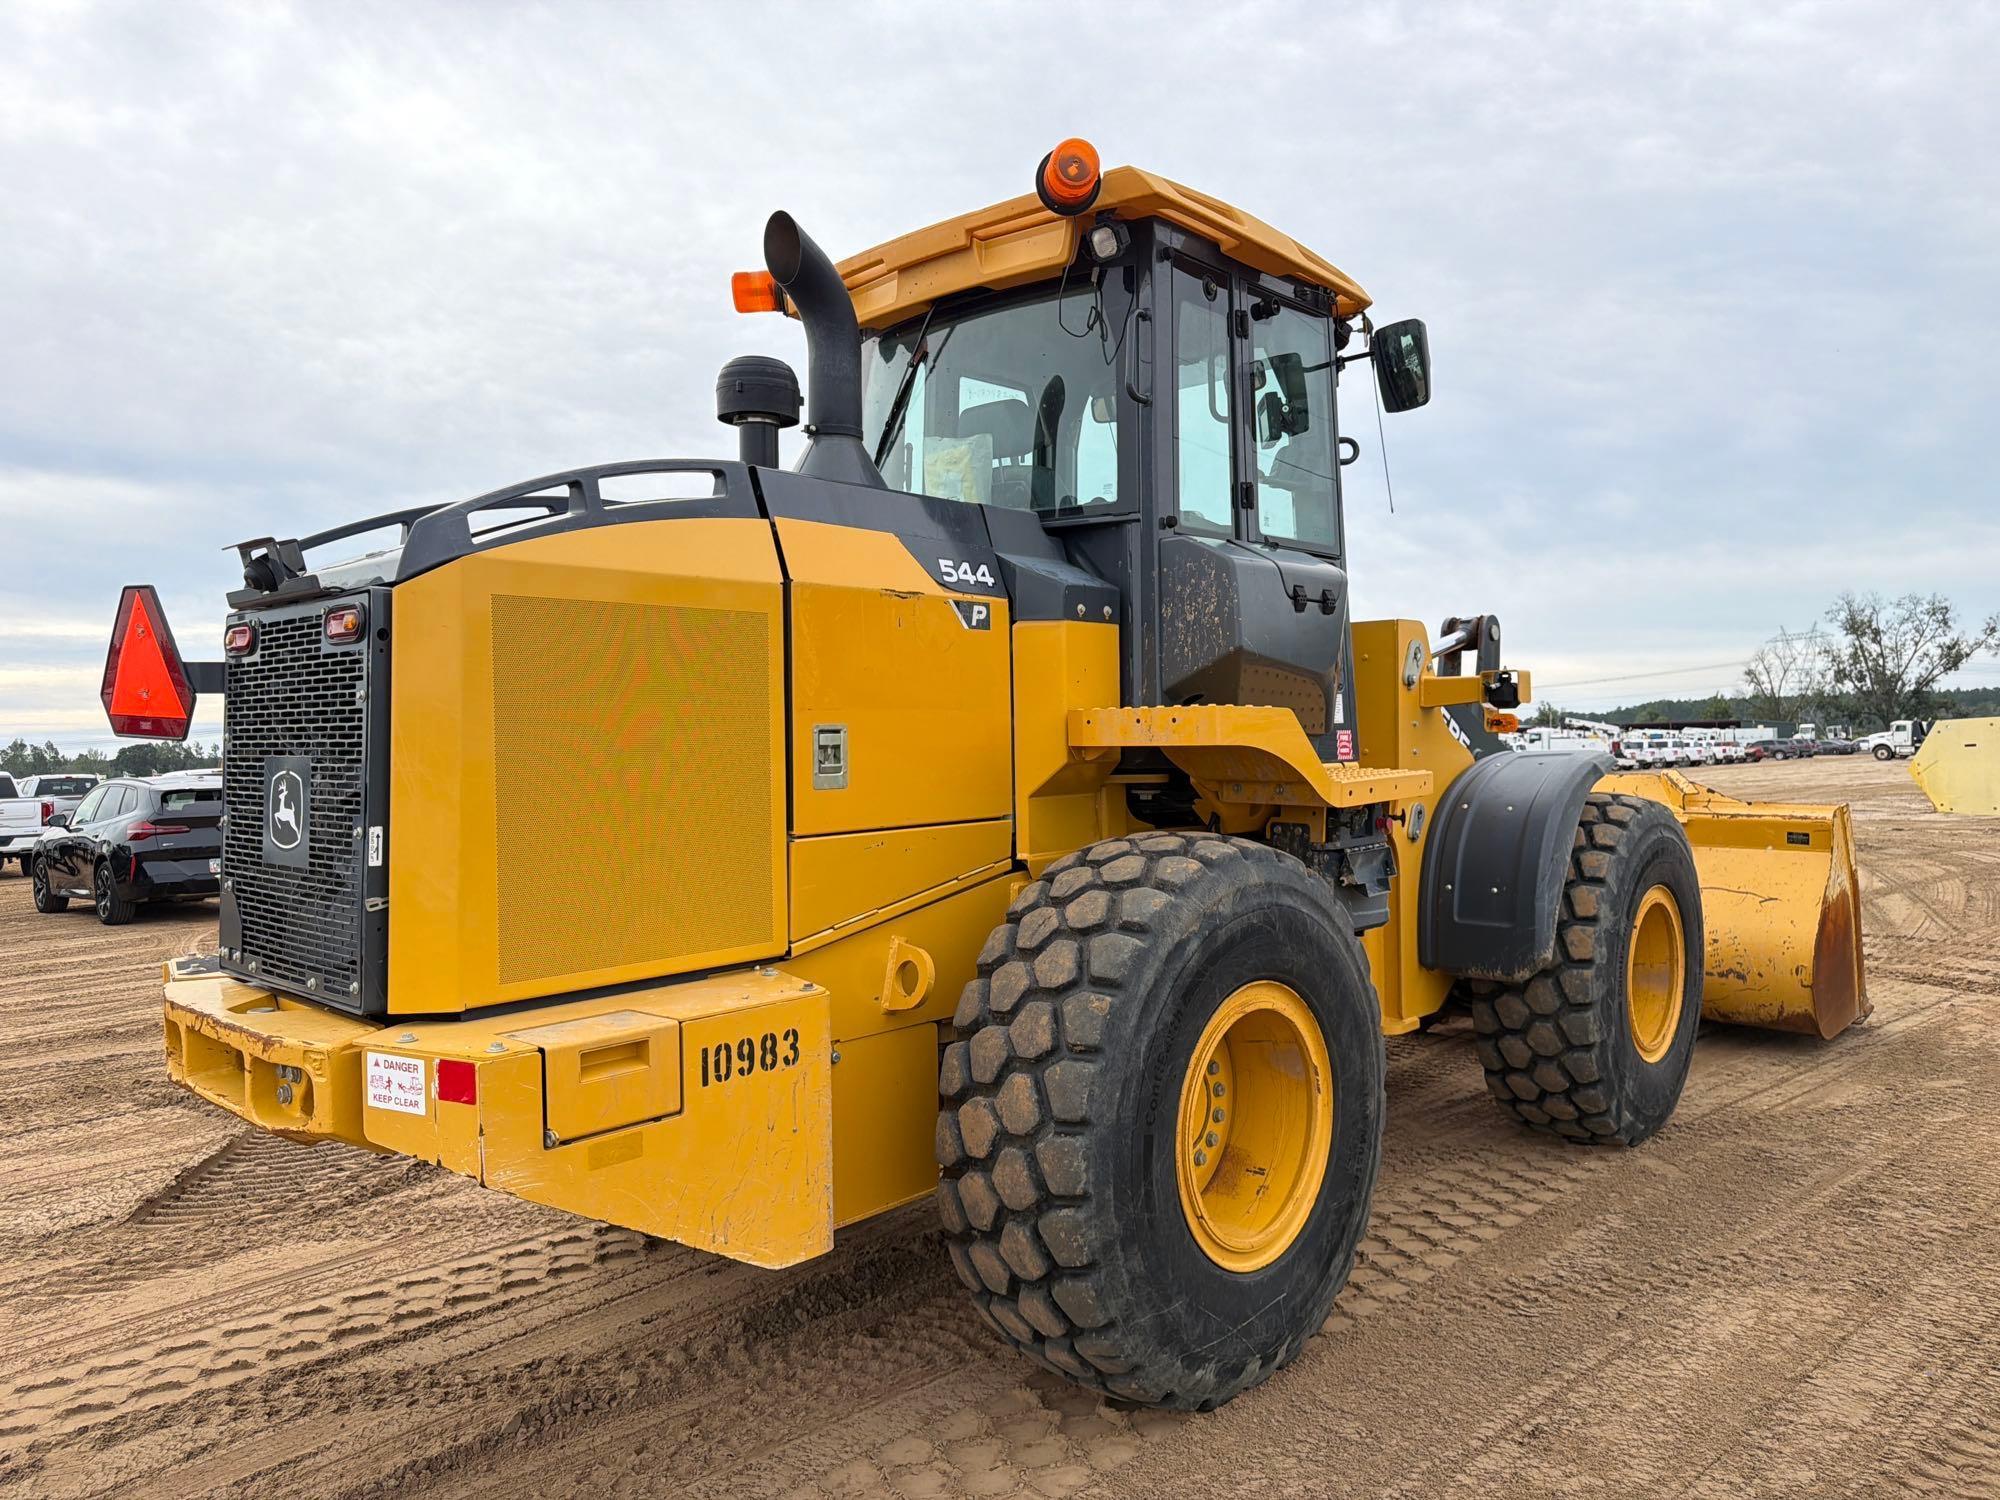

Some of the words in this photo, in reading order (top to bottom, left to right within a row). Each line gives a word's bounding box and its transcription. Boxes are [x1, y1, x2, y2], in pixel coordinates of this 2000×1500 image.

[938, 558, 995, 587] 544
[971, 604, 987, 626] P
[383, 1059, 419, 1074] DANGER
[701, 1028, 800, 1087] 10983
[373, 1093, 393, 1103] KEEP
[394, 1096, 420, 1109] CLEAR
